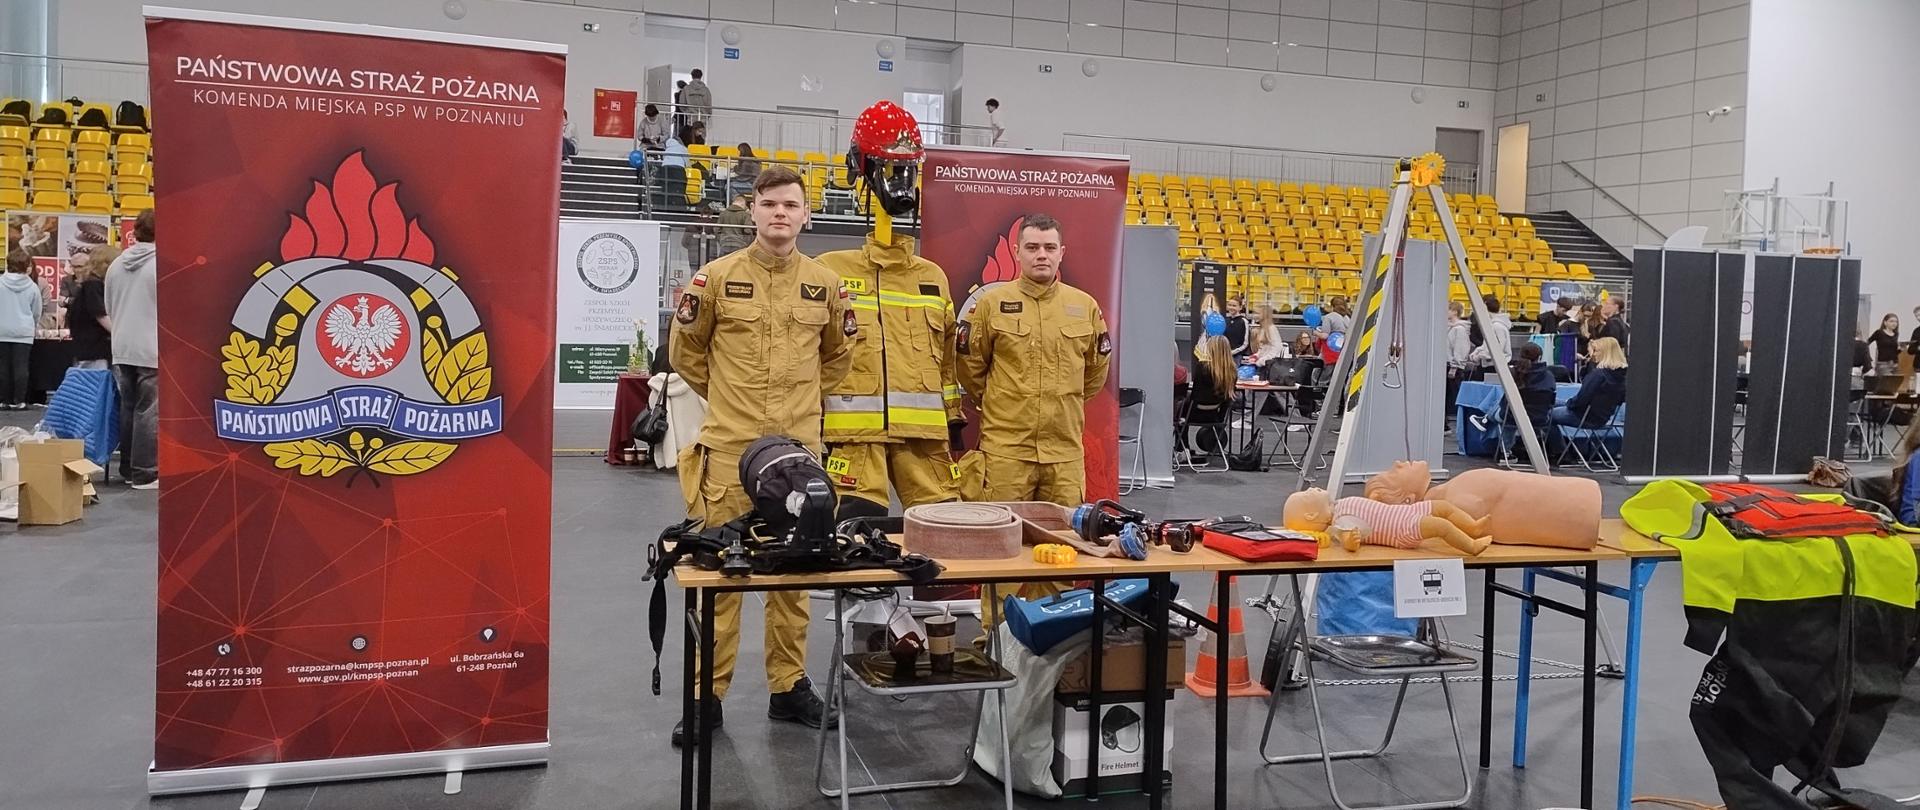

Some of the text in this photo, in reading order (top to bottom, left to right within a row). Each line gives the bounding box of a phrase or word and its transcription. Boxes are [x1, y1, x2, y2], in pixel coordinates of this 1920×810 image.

[177, 54, 540, 103] PAŃSTWOWA STRAŻ POŻARNA
[194, 89, 524, 127] KOMENDA MIEJSKA PSP W POZNANIU
[935, 164, 1115, 186] PAŃSTWOWA STRAŻ POŻARNA
[954, 183, 1099, 199] KOMENDA MIEJSKA PSP W POZNANIU
[843, 279, 863, 289] PSP
[221, 394, 494, 436] PAŃSTWOWA STRAŻ POŻARNA
[828, 459, 846, 472] PSP
[450, 651, 525, 663] ul. Bobrzańska 6a
[186, 669, 203, 677] +48
[219, 668, 230, 676] 77
[233, 667, 244, 675] 16
[245, 667, 263, 675] 300
[287, 657, 430, 673] strazpozarna@kmpsp.poznan.pl
[456, 660, 518, 673] 61-248 Poznań
[186, 679, 203, 688] +48
[205, 679, 216, 687] 61
[232, 678, 244, 686] 20
[245, 677, 263, 686] 315
[297, 669, 419, 684] www.gov.pl/kmpsp-poznan
[1100, 761, 1139, 771] Fire Helmet
